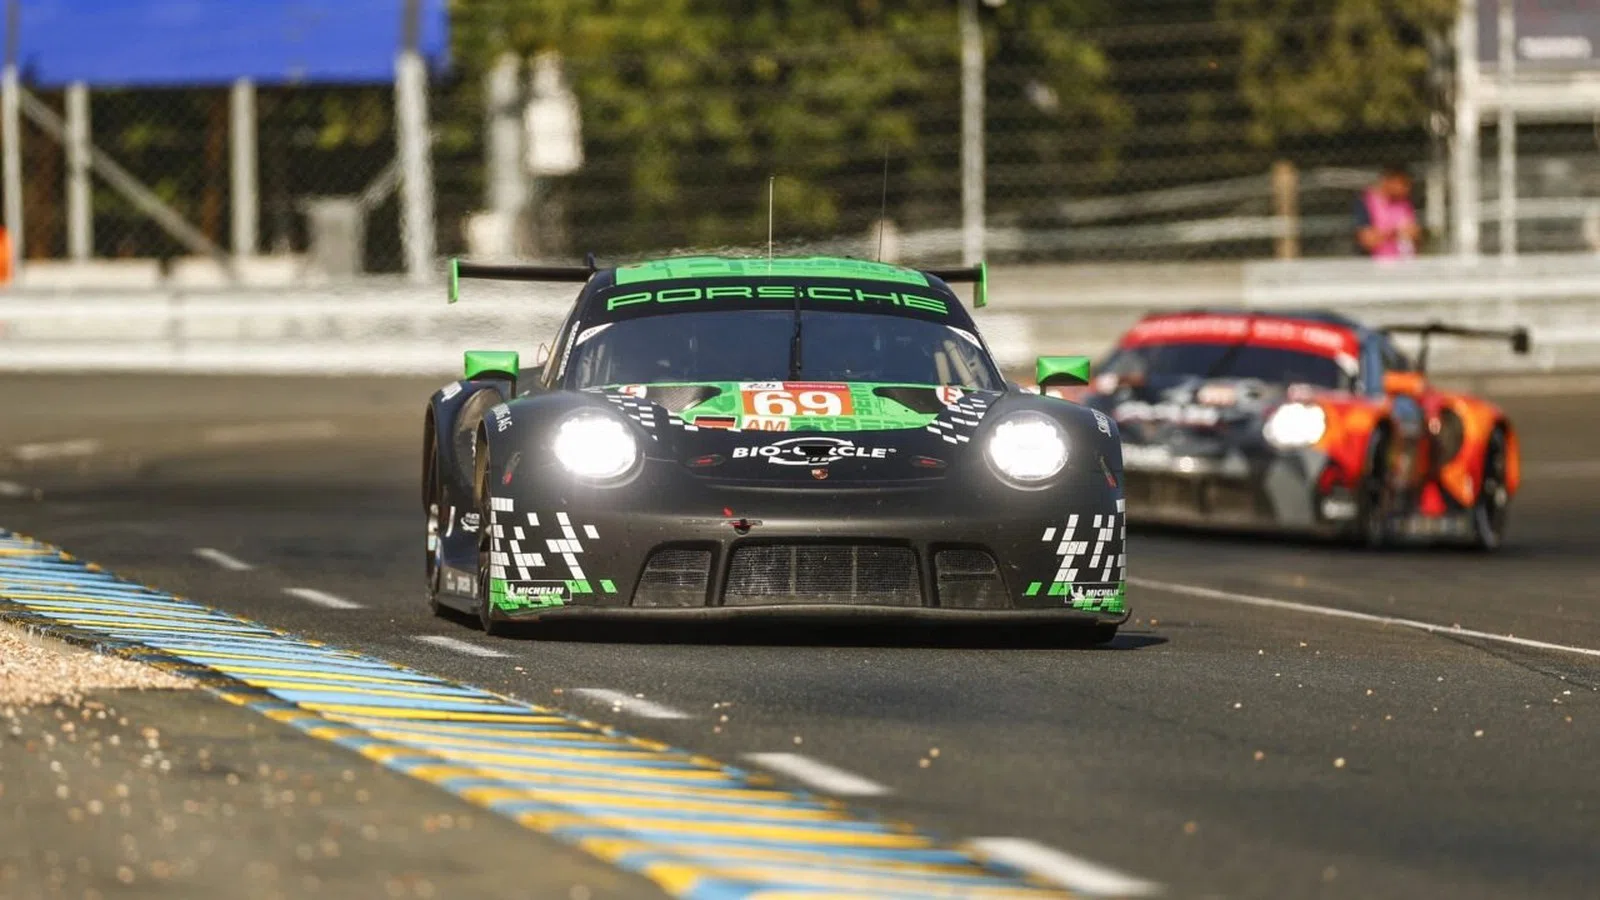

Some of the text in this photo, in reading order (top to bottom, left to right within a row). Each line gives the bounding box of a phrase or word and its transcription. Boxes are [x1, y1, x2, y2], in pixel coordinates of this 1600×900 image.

[606, 286, 948, 314] PORSCHE
[753, 390, 843, 416] 69
[746, 420, 787, 431] AM
[516, 586, 565, 596] MICHELIN
